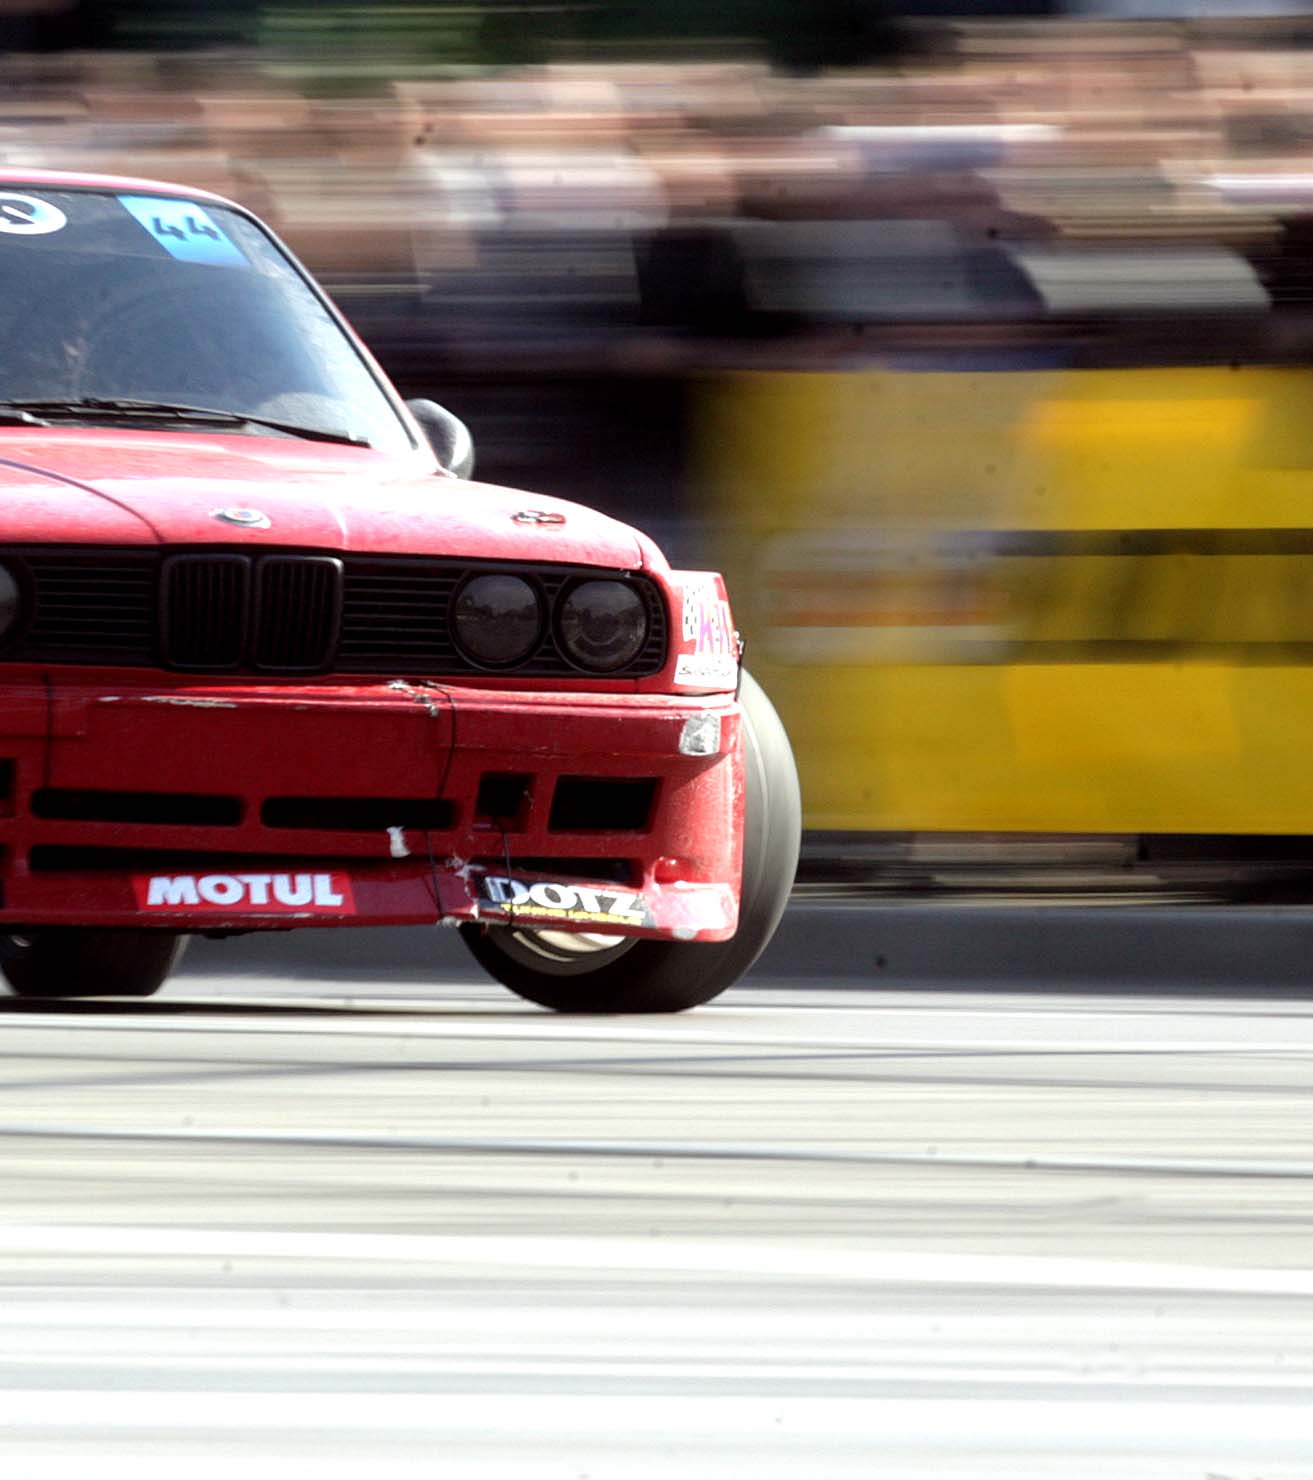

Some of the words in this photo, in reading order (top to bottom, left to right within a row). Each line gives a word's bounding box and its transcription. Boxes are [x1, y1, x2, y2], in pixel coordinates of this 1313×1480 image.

[152, 216, 221, 242] 44
[147, 874, 344, 906] MOTUL
[485, 876, 645, 919] DOTZ
